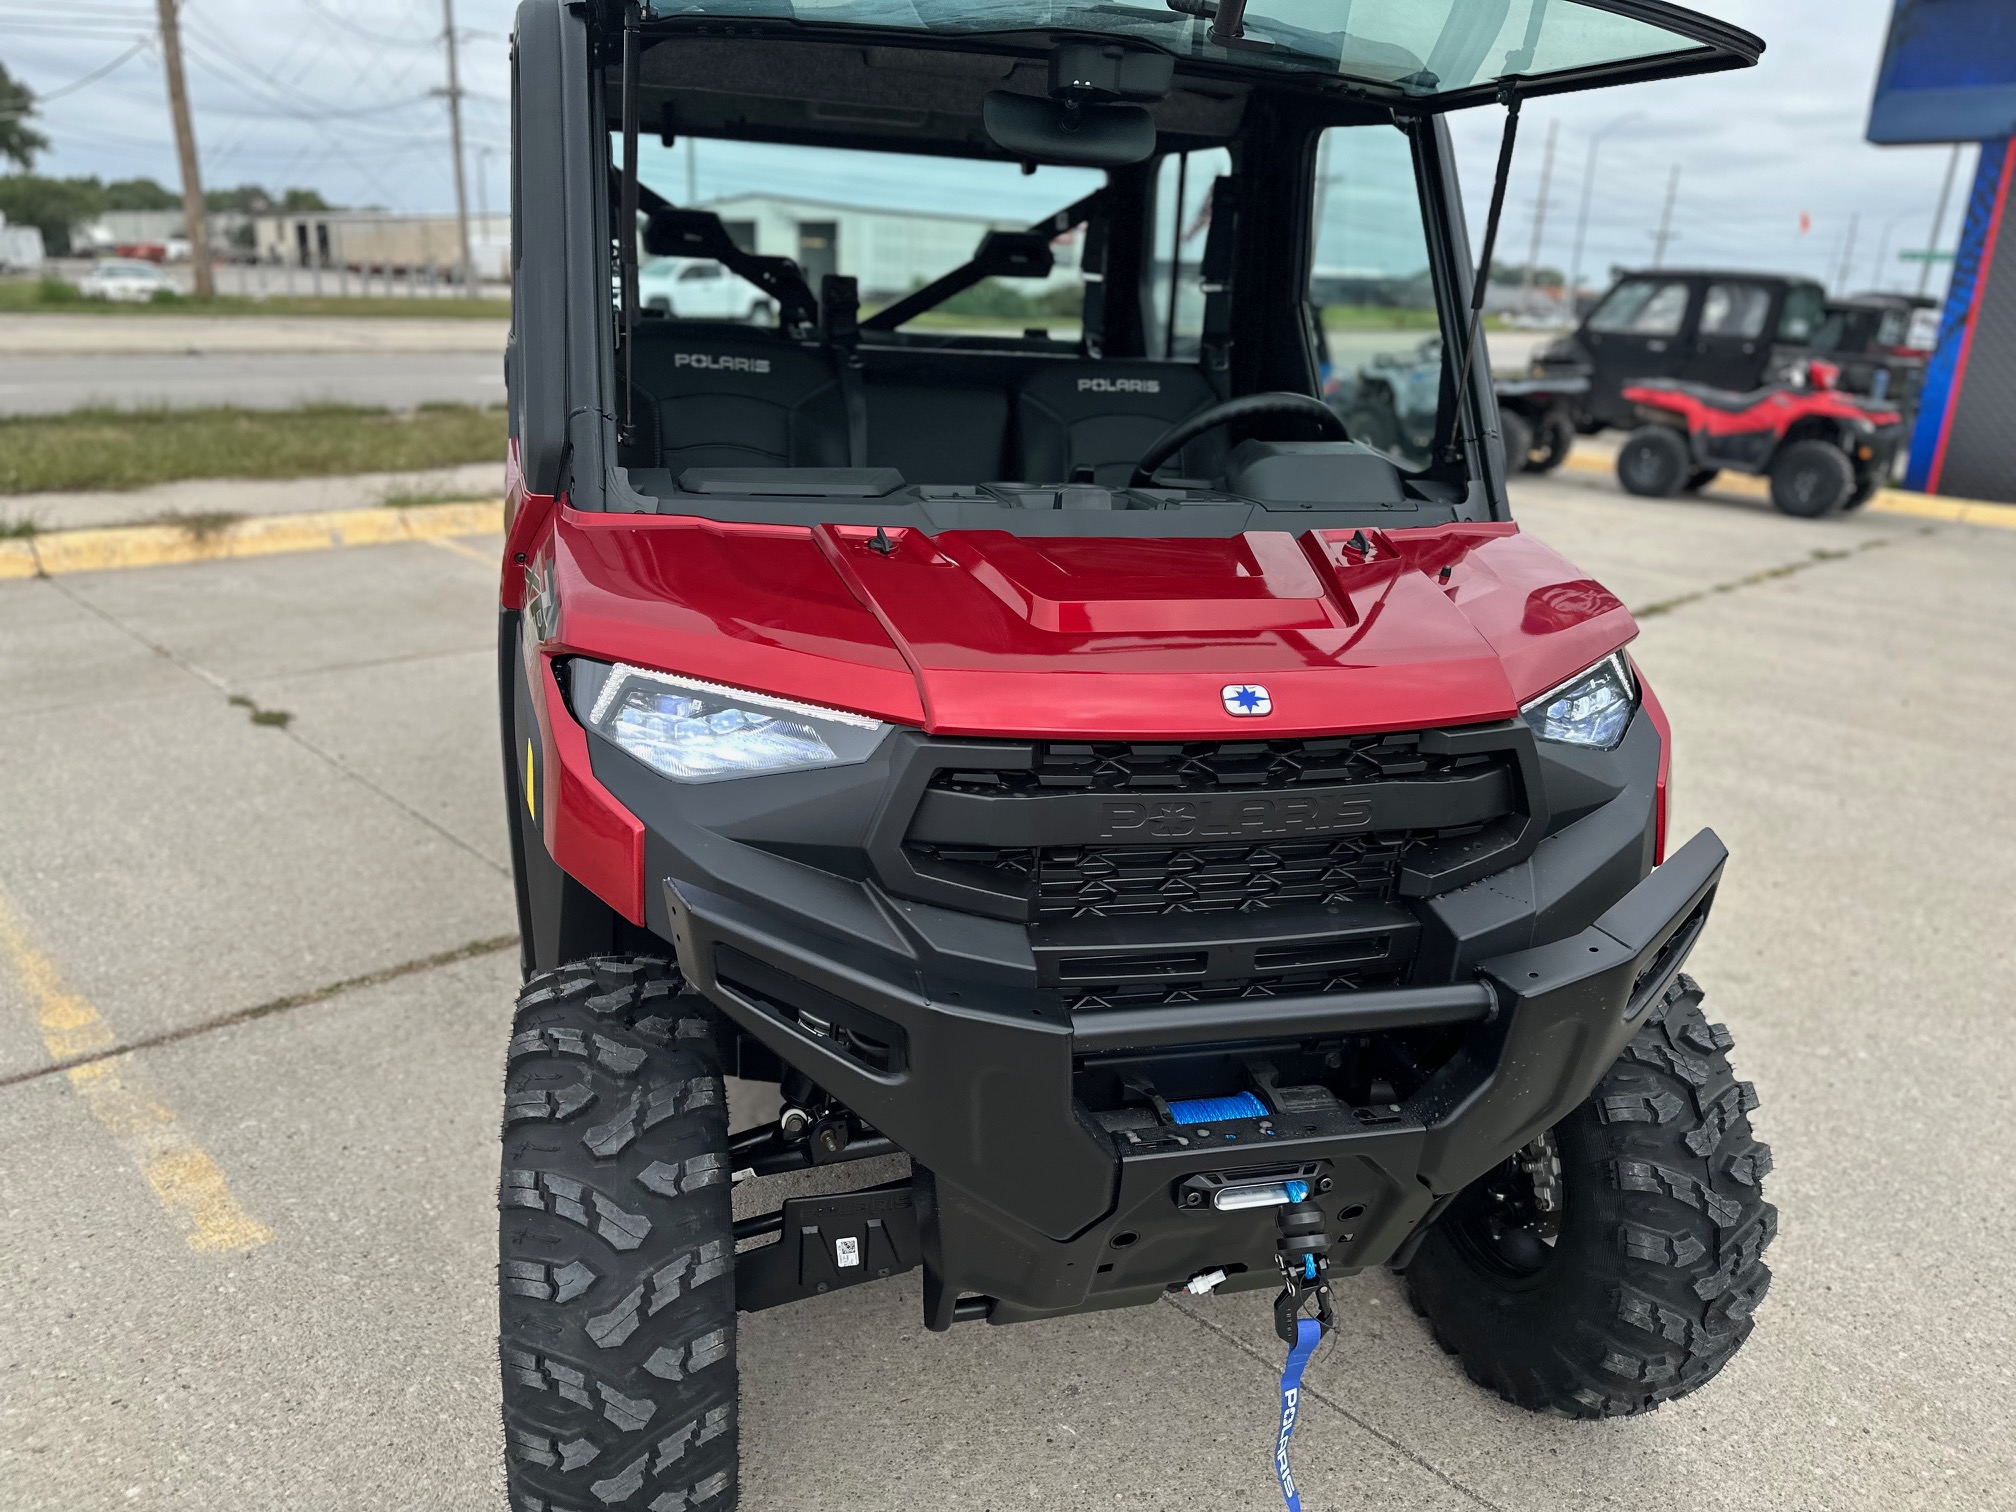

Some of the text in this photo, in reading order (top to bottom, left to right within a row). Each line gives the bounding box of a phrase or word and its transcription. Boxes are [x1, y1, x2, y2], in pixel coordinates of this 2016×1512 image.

[674, 353, 770, 373] POLARIS
[1078, 378, 1160, 393] POLARIS
[1100, 792, 1372, 837] POLARIS
[1277, 1387, 1298, 1498] POLARIS
